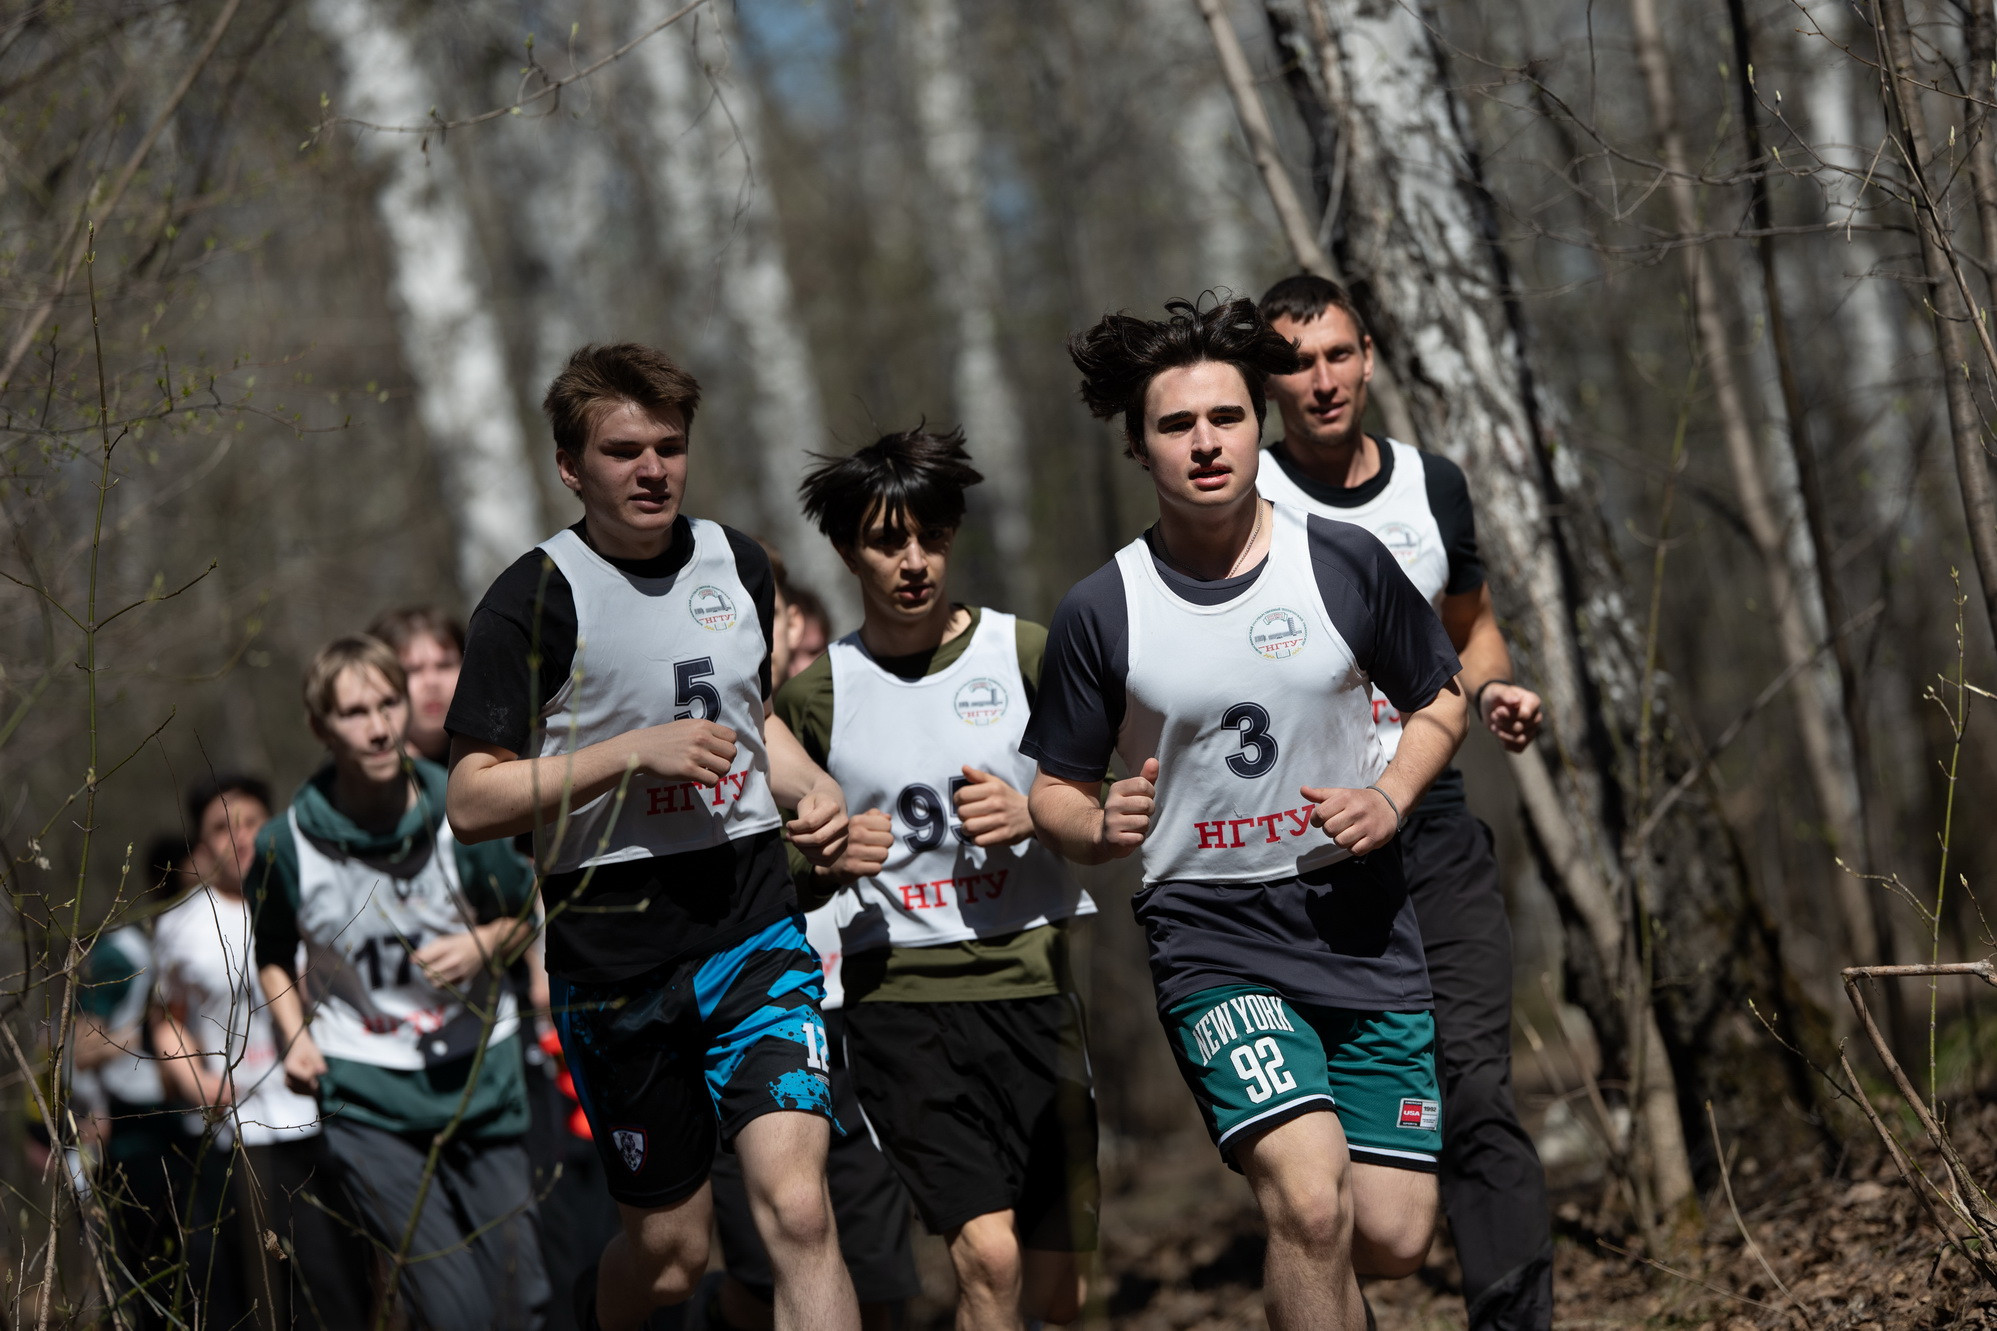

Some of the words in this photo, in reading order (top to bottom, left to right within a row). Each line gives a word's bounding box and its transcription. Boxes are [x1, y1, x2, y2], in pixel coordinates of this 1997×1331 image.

[1265, 639, 1298, 652] НГТУ
[673, 656, 722, 724] 5
[1220, 701, 1279, 779] 3
[1194, 803, 1316, 849] НГТУ
[899, 869, 1009, 911] НГТУ
[1192, 1001, 1238, 1067] NEW
[1229, 994, 1295, 1034] YORK
[1230, 1036, 1298, 1104] 92
